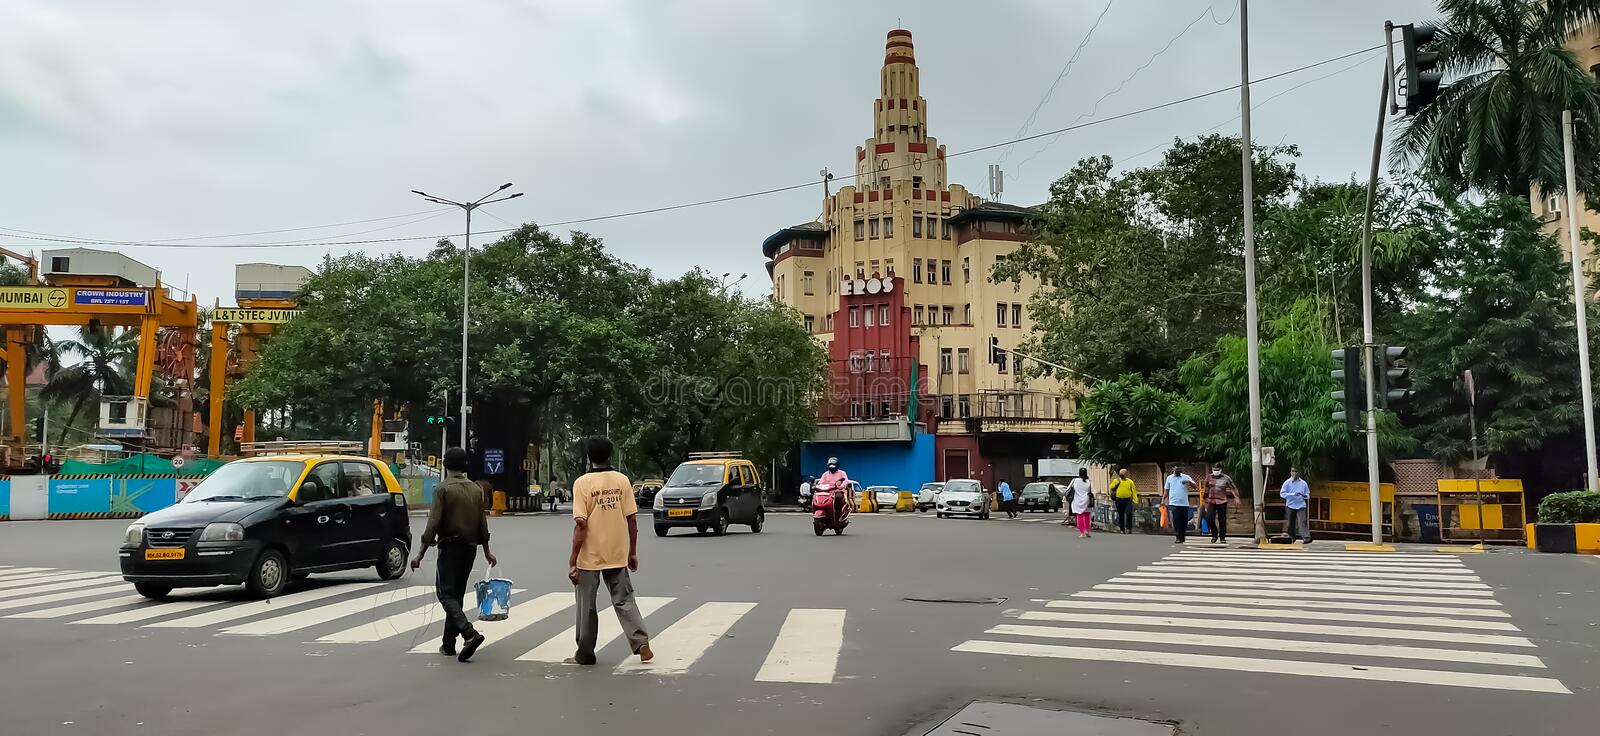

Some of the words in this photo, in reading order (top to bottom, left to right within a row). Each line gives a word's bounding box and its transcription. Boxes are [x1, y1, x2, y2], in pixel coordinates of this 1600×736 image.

[839, 277, 894, 295] EROS
[215, 310, 236, 320] L&T
[238, 310, 265, 320] STEC
[267, 310, 280, 321] JV
